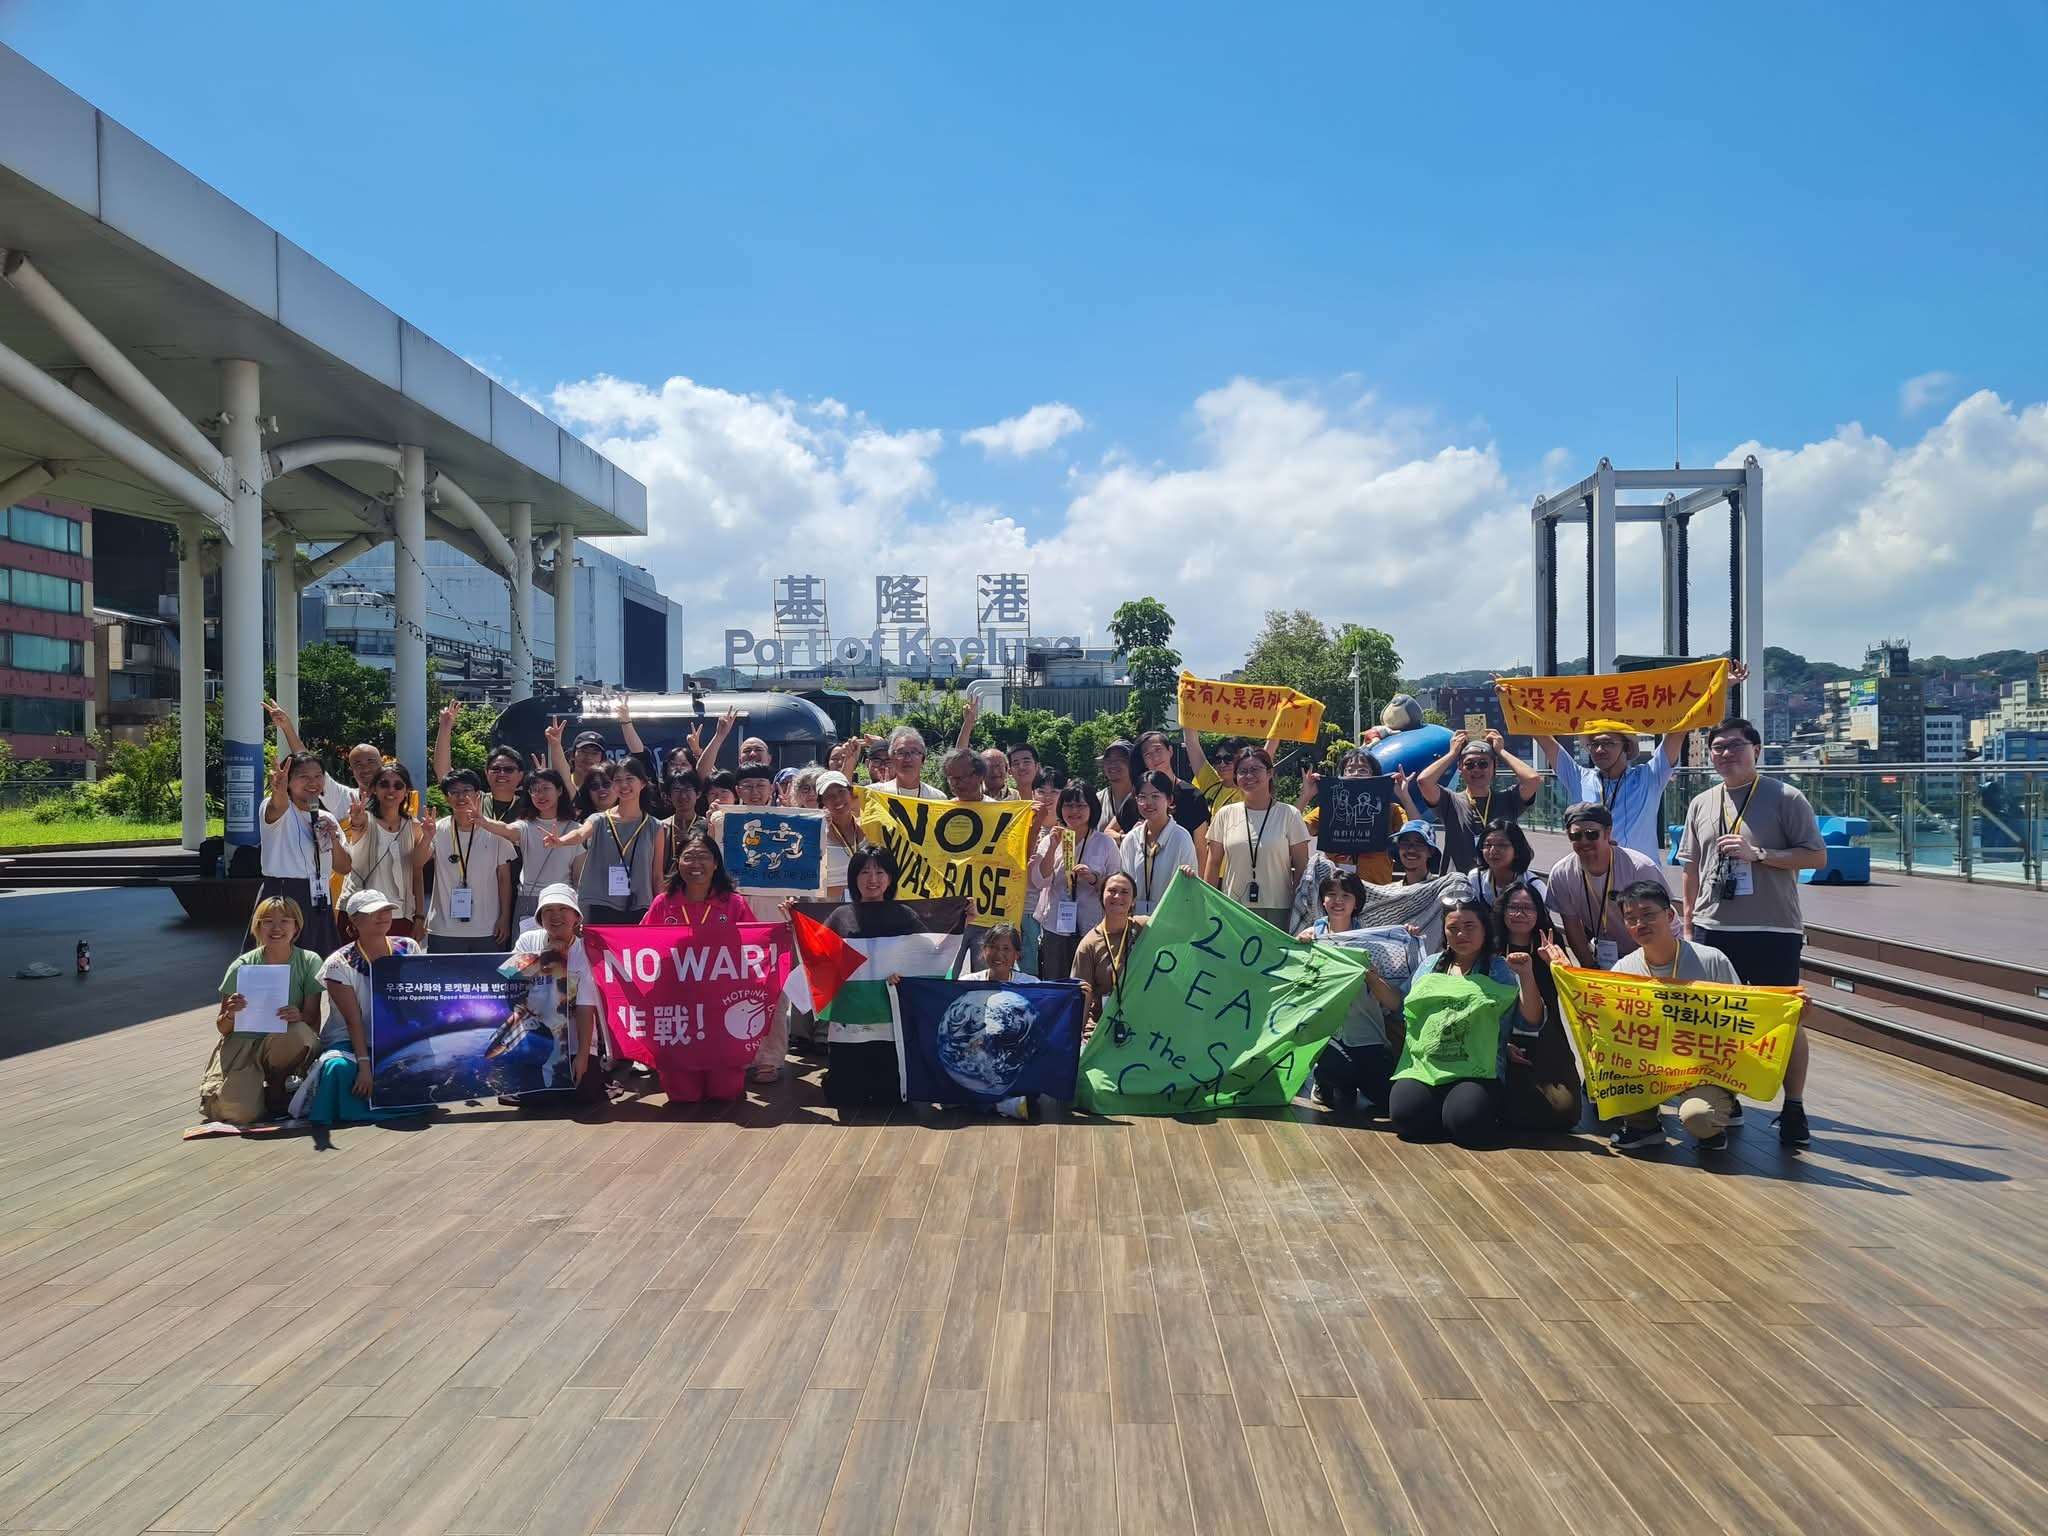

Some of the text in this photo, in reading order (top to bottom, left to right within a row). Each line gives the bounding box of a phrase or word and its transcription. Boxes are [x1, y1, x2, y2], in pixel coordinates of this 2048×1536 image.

[775, 573, 1028, 625] 基隆港
[725, 627, 822, 667] Port
[836, 628, 888, 666] of
[887, 797, 1014, 855] NO!
[943, 862, 1011, 917] BASE
[603, 943, 778, 984] NO WAR!
[1611, 1020, 1661, 1052] 산업
[1615, 997, 1654, 1018] 재앙
[1661, 1003, 1757, 1036] 악화시키는
[1611, 1051, 1633, 1069] the
[1593, 1081, 1645, 1100] erbates
